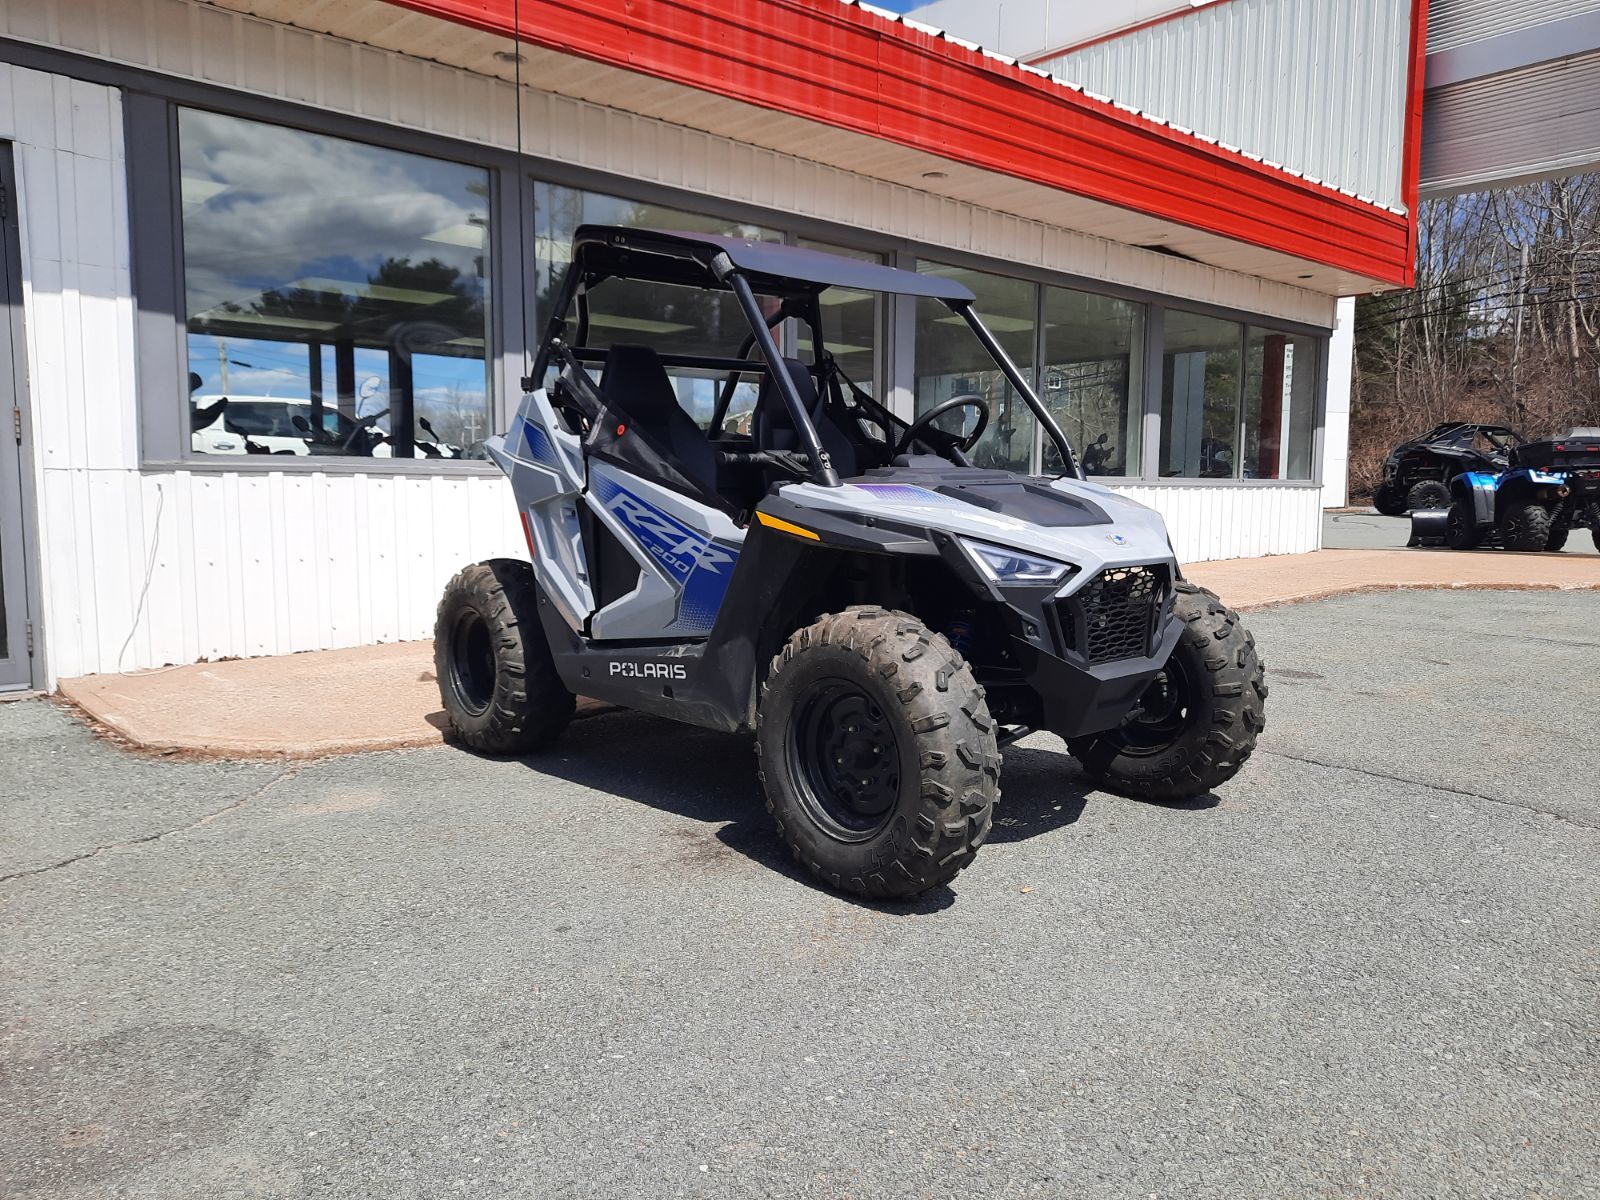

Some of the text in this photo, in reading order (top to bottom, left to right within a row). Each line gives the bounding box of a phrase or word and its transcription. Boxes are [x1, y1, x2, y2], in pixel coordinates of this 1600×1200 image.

[611, 493, 734, 575] RZR
[650, 543, 690, 573] 200
[609, 662, 687, 679] POLARIS
